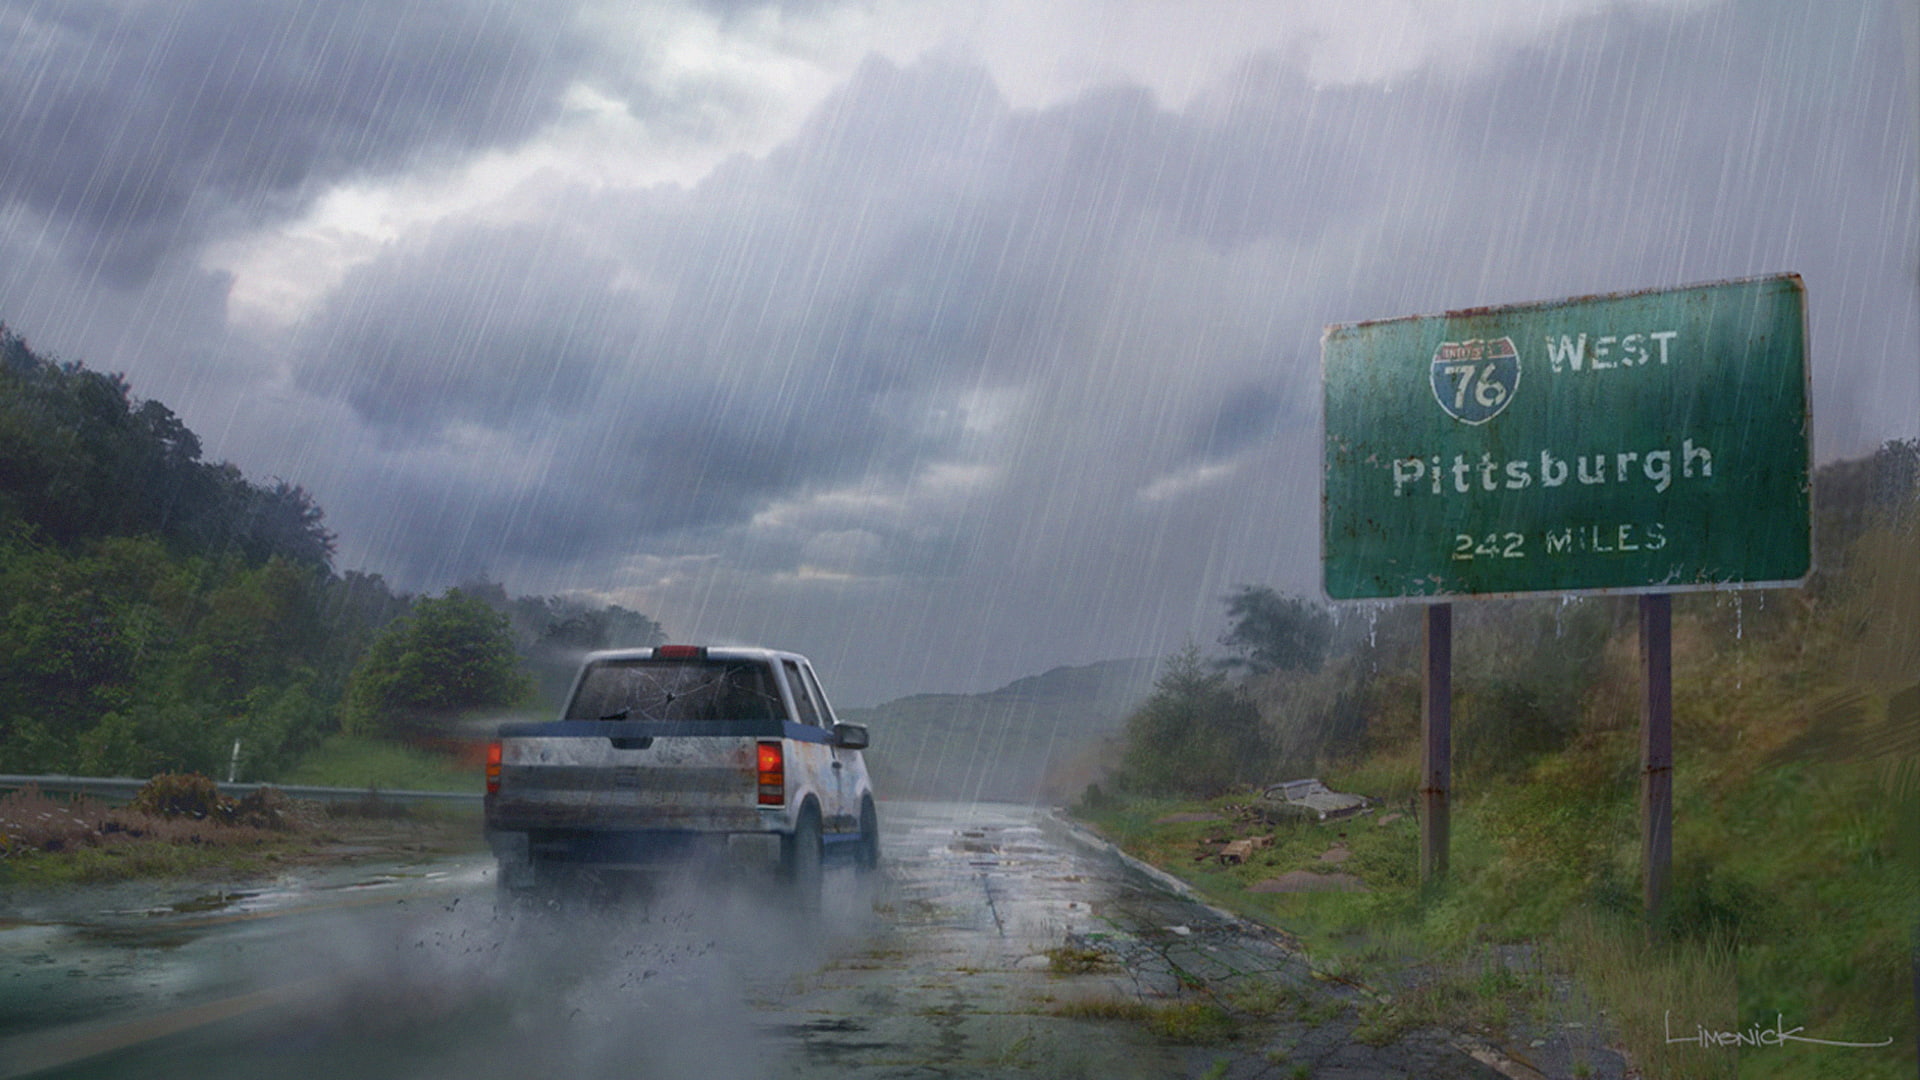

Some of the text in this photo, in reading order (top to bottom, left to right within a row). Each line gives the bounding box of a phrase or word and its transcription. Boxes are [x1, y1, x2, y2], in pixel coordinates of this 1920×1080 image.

[1445, 331, 1677, 408] 76 WEST
[1393, 438, 1712, 496] Pittsburgh
[1452, 522, 1667, 560] 242 MILES
